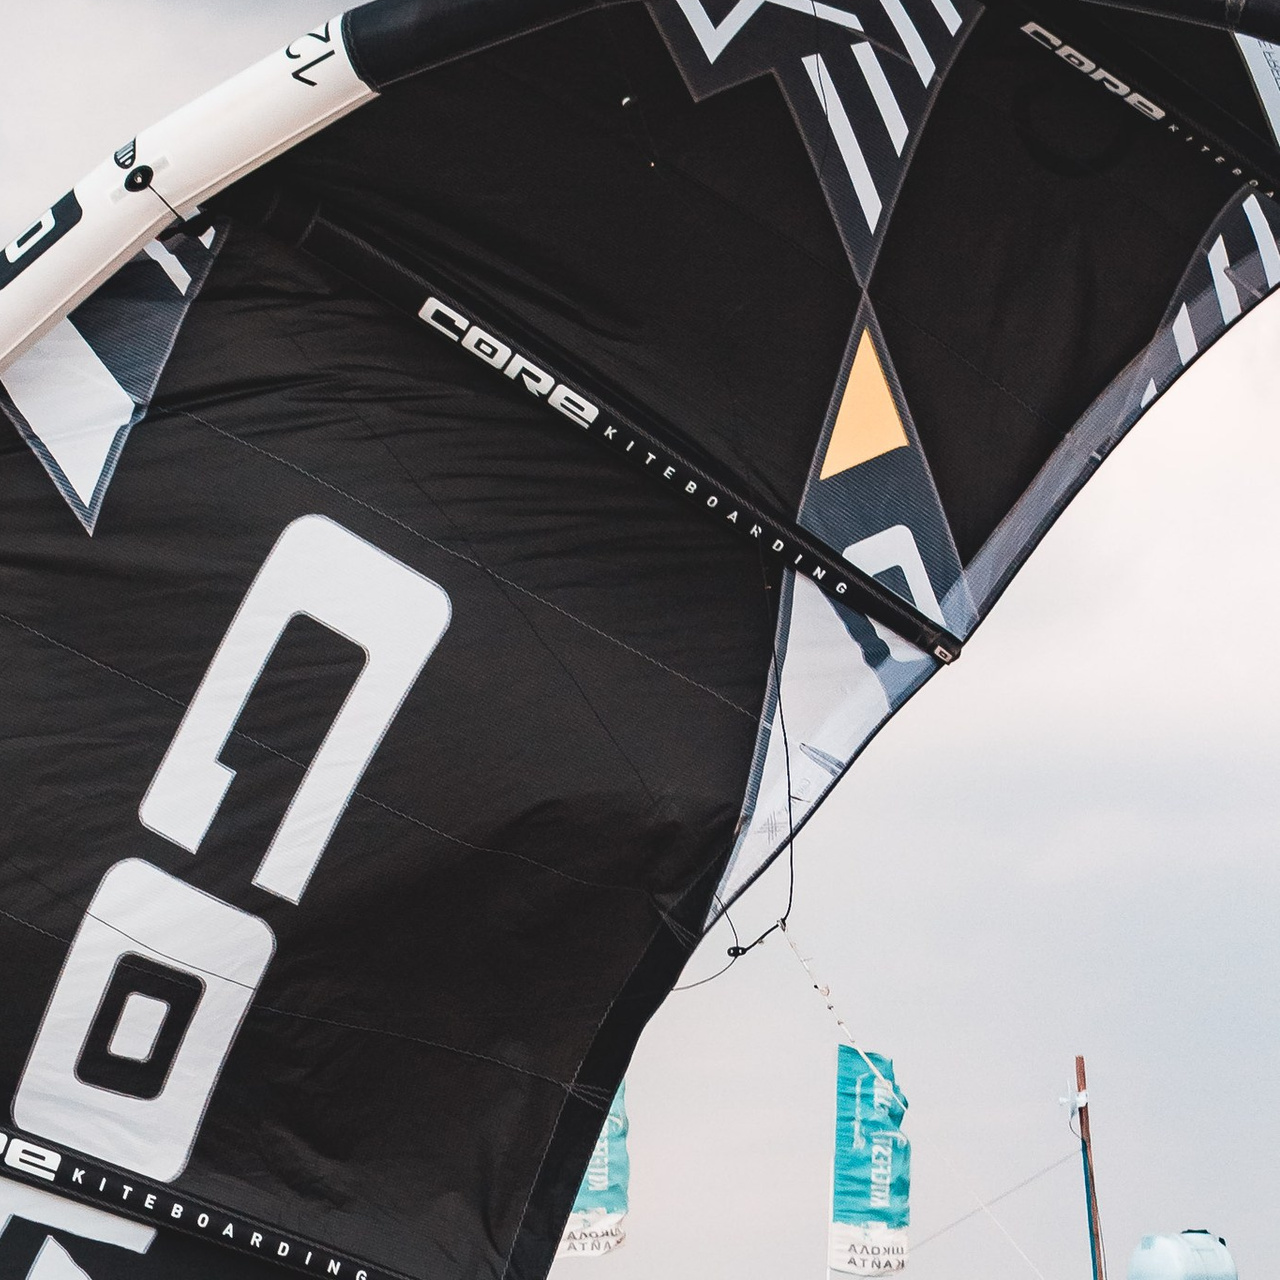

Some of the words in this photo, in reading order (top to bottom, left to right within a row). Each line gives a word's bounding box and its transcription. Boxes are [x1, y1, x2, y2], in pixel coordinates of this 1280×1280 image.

[1020, 21, 1166, 121] CORE
[418, 296, 599, 430] CORE
[604, 425, 848, 596] KITEBOARDING
